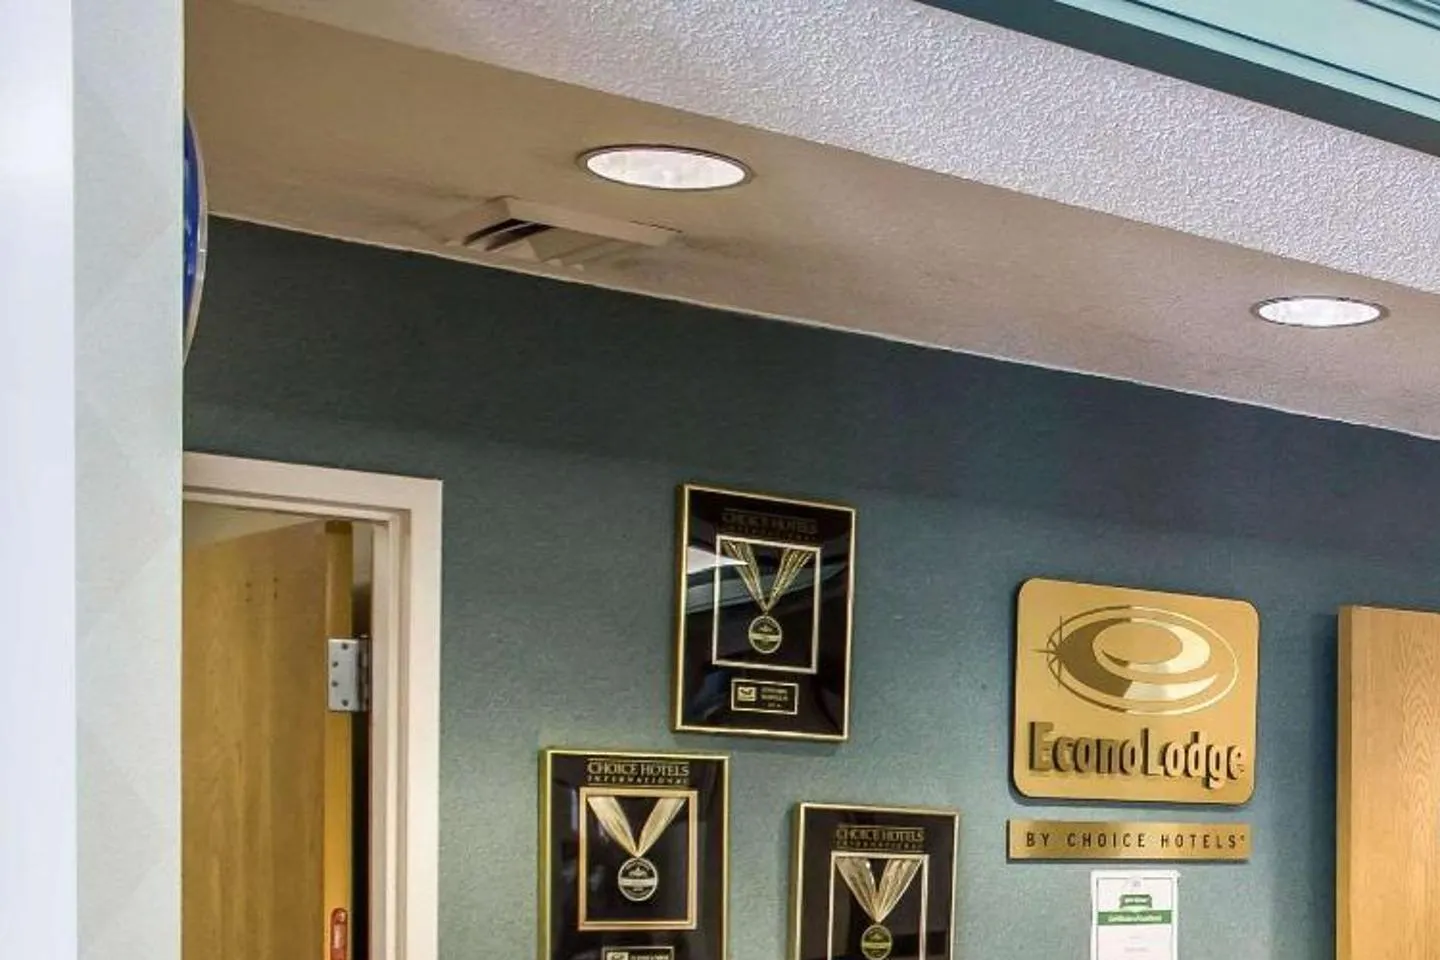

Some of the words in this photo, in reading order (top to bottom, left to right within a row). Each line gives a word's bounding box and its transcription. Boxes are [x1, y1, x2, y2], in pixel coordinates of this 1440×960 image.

[587, 761, 639, 775] CHOICE
[641, 763, 690, 777] HOTELS
[1026, 831, 1051, 847] BY
[1066, 832, 1146, 848] CHOICE
